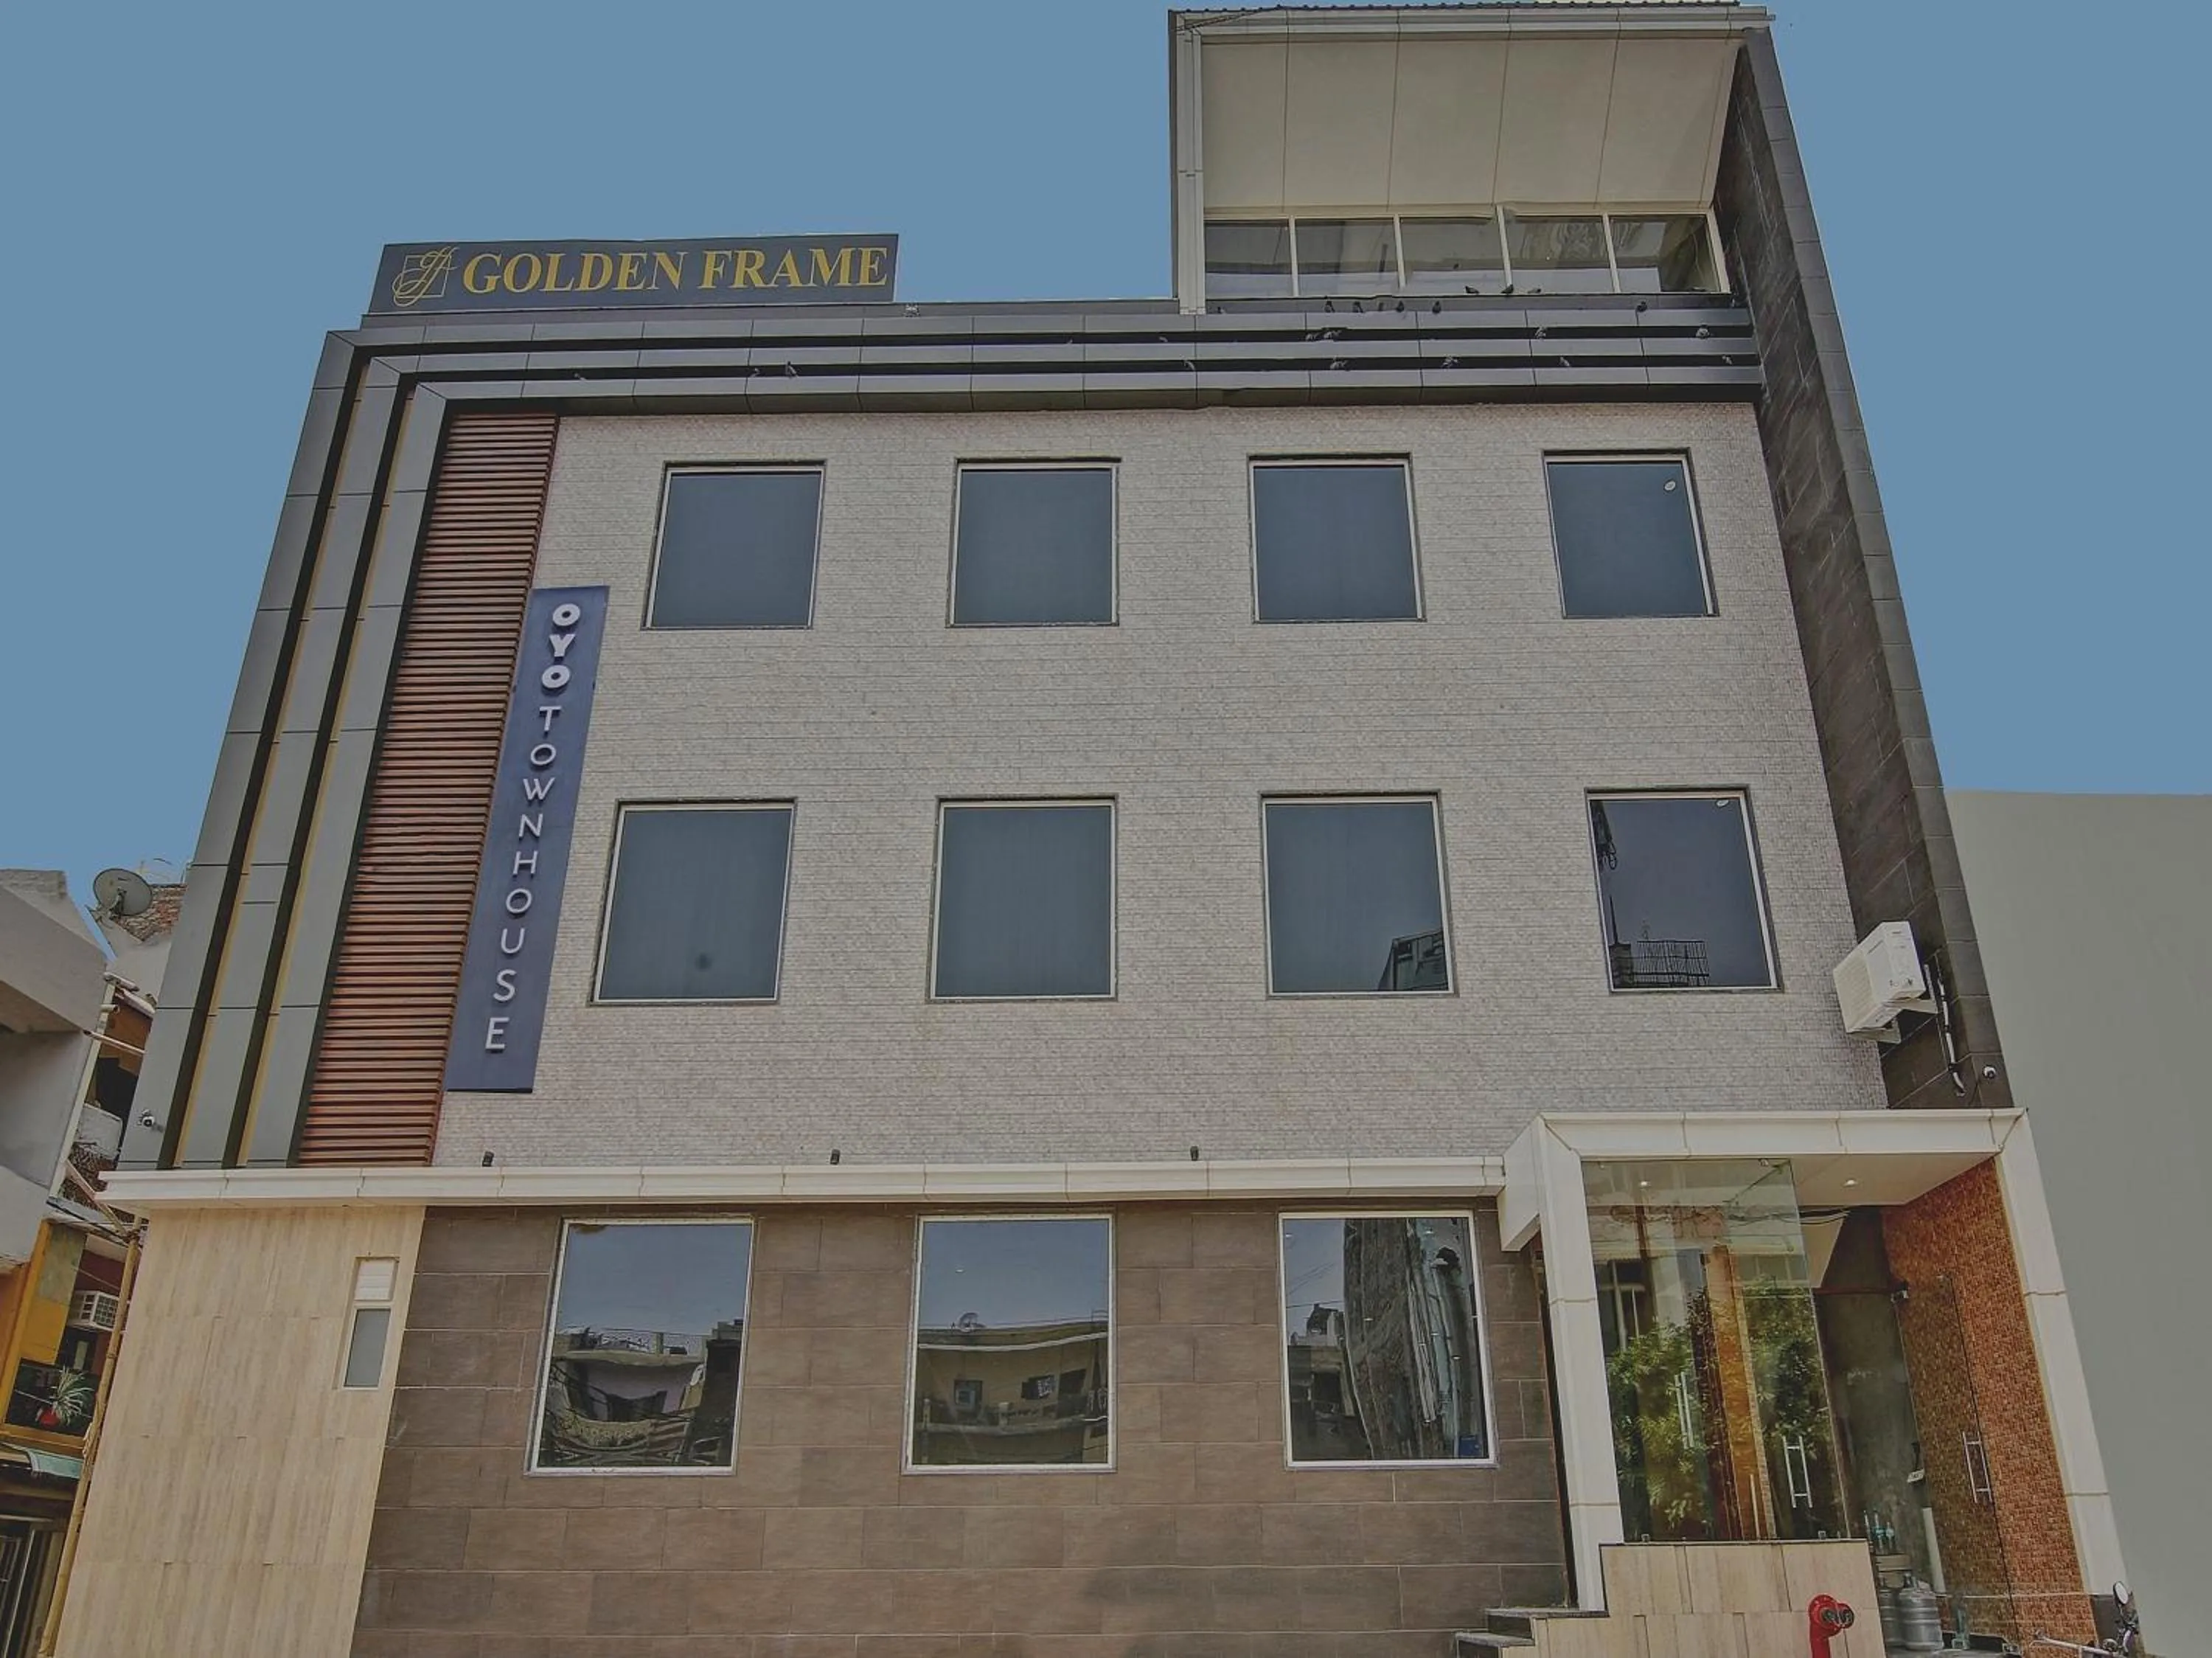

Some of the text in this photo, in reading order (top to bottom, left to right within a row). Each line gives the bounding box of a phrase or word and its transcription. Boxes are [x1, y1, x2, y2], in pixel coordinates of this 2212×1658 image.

[463, 251, 688, 293] GOLDEN
[697, 247, 888, 288] FRAME
[484, 603, 580, 1050] OYO TOWNHOUSE
